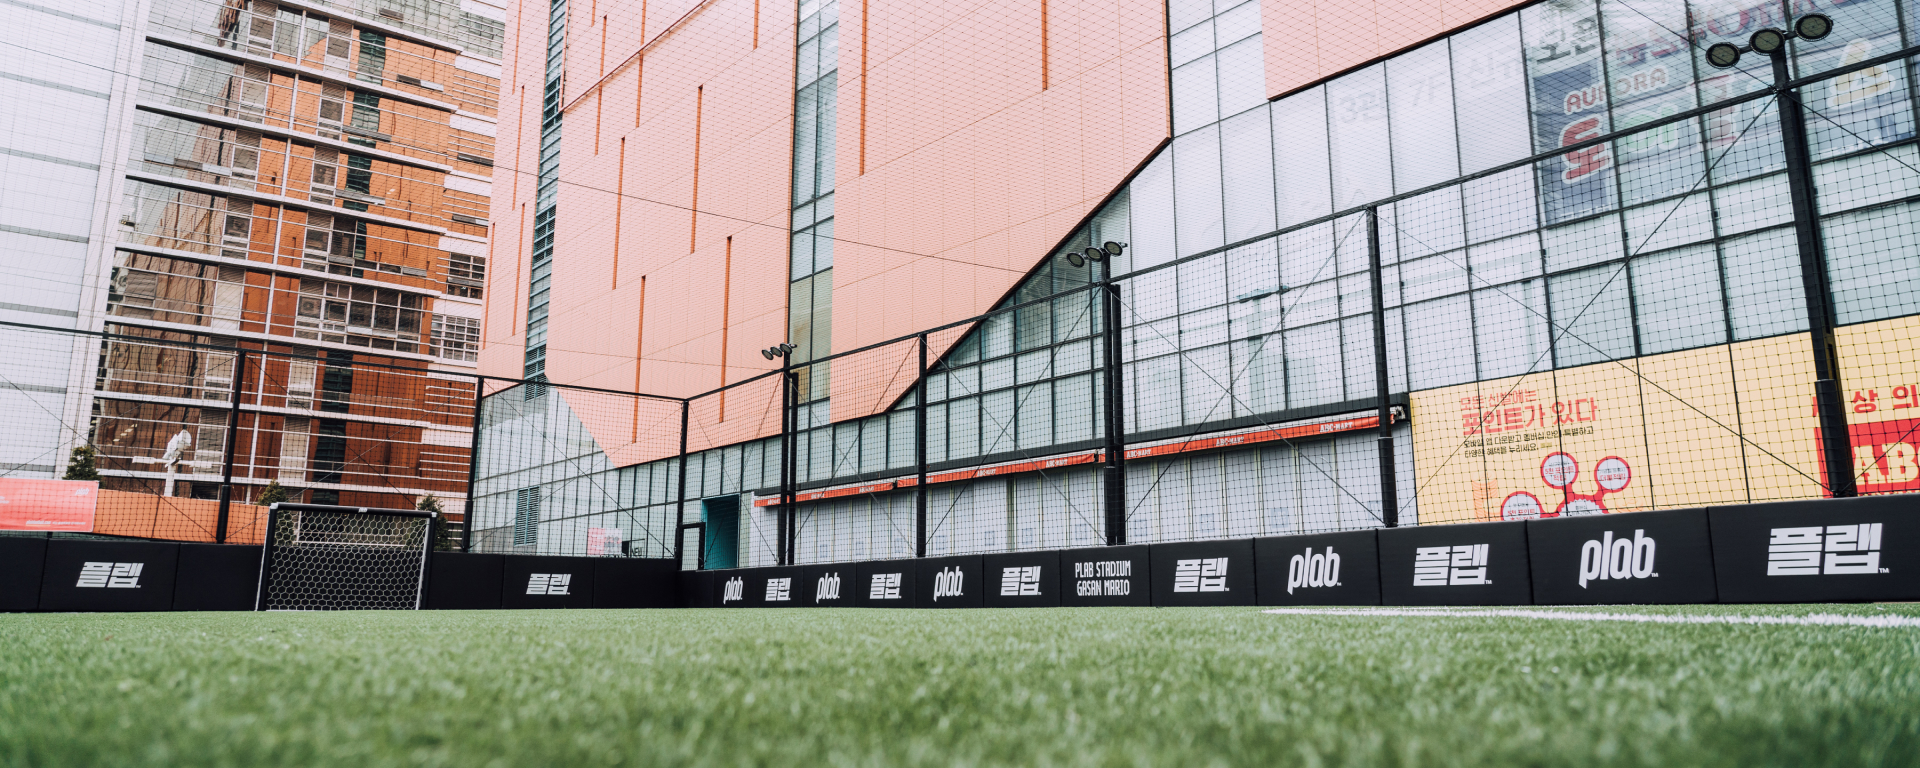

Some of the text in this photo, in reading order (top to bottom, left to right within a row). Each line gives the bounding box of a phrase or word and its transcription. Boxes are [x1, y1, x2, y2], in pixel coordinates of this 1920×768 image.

[1565, 67, 1668, 113] AURORA
[1460, 388, 1537, 411] 모든 신발에는
[1462, 397, 1598, 436] 포인트가 있다
[1851, 442, 1920, 485] AB
[1579, 529, 1656, 589] plab
[1767, 523, 1883, 575] 플랩
[76, 562, 144, 588] 플랩
[1001, 566, 1041, 595] 플랩
[1075, 560, 1131, 578] PLAB STADIUM
[1174, 558, 1230, 592] 플랩
[1287, 546, 1341, 595] plab
[1413, 544, 1490, 586] 플랩
[526, 574, 572, 594] 플랩
[724, 577, 743, 604] plab
[766, 578, 789, 601] 플랩
[816, 572, 840, 603] plab
[870, 573, 902, 599] 플랩
[934, 566, 963, 602] plab
[1077, 579, 1129, 596] GASAN MARIO
